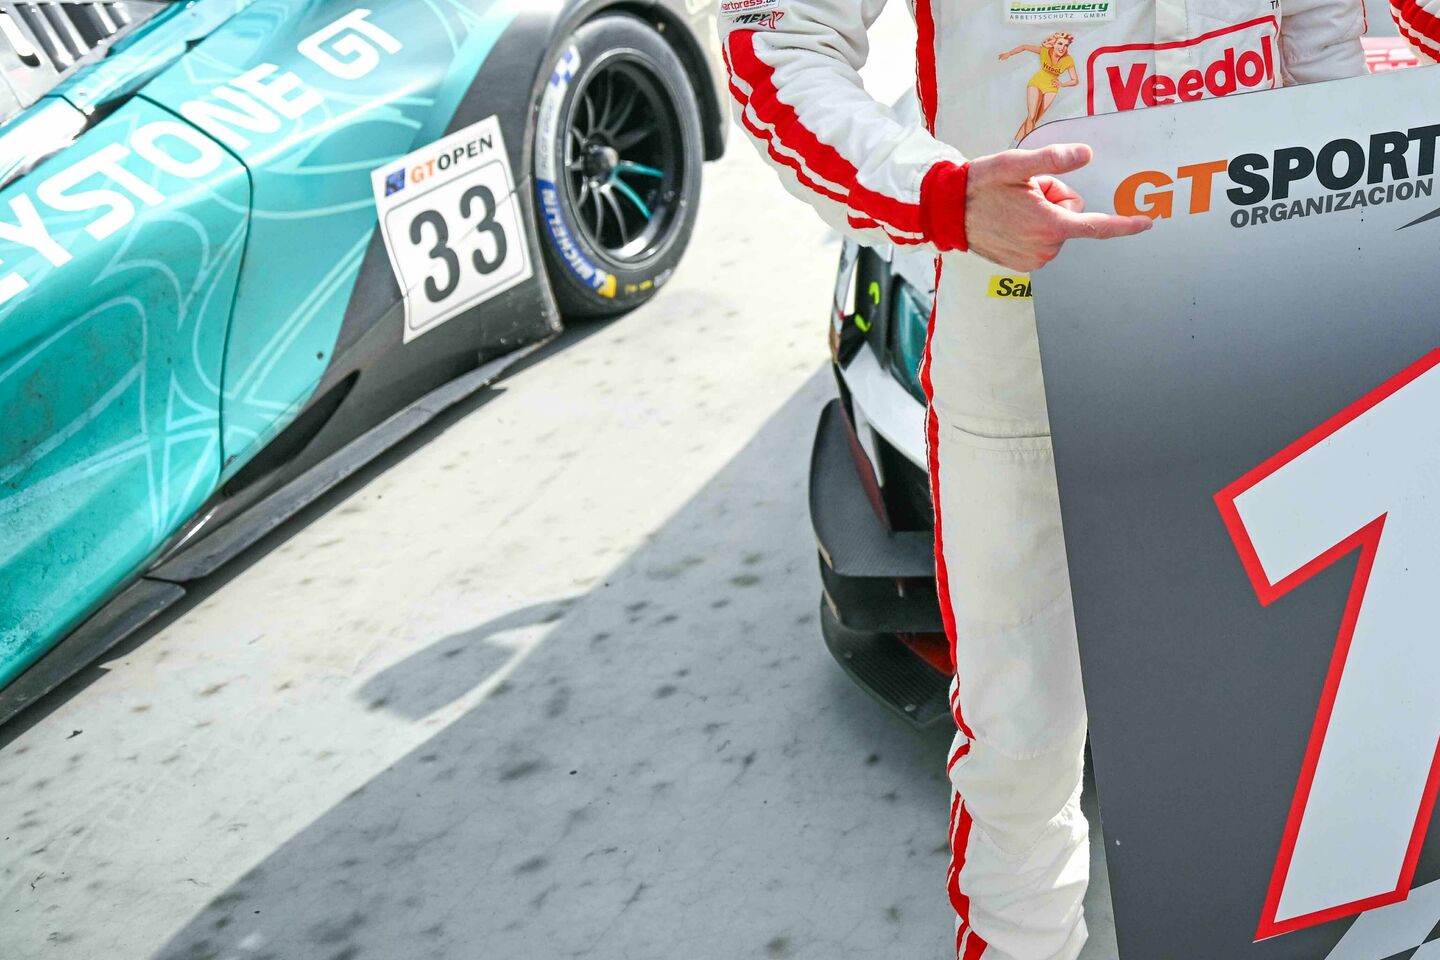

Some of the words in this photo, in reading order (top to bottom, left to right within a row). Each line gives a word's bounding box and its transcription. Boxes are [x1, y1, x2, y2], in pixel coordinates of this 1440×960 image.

[297, 8, 403, 80] GT
[1106, 35, 1273, 112] Veedol
[541, 188, 594, 280] MICHELIN
[1229, 178, 1434, 228] ORGANIZACION
[409, 184, 508, 303] 33
